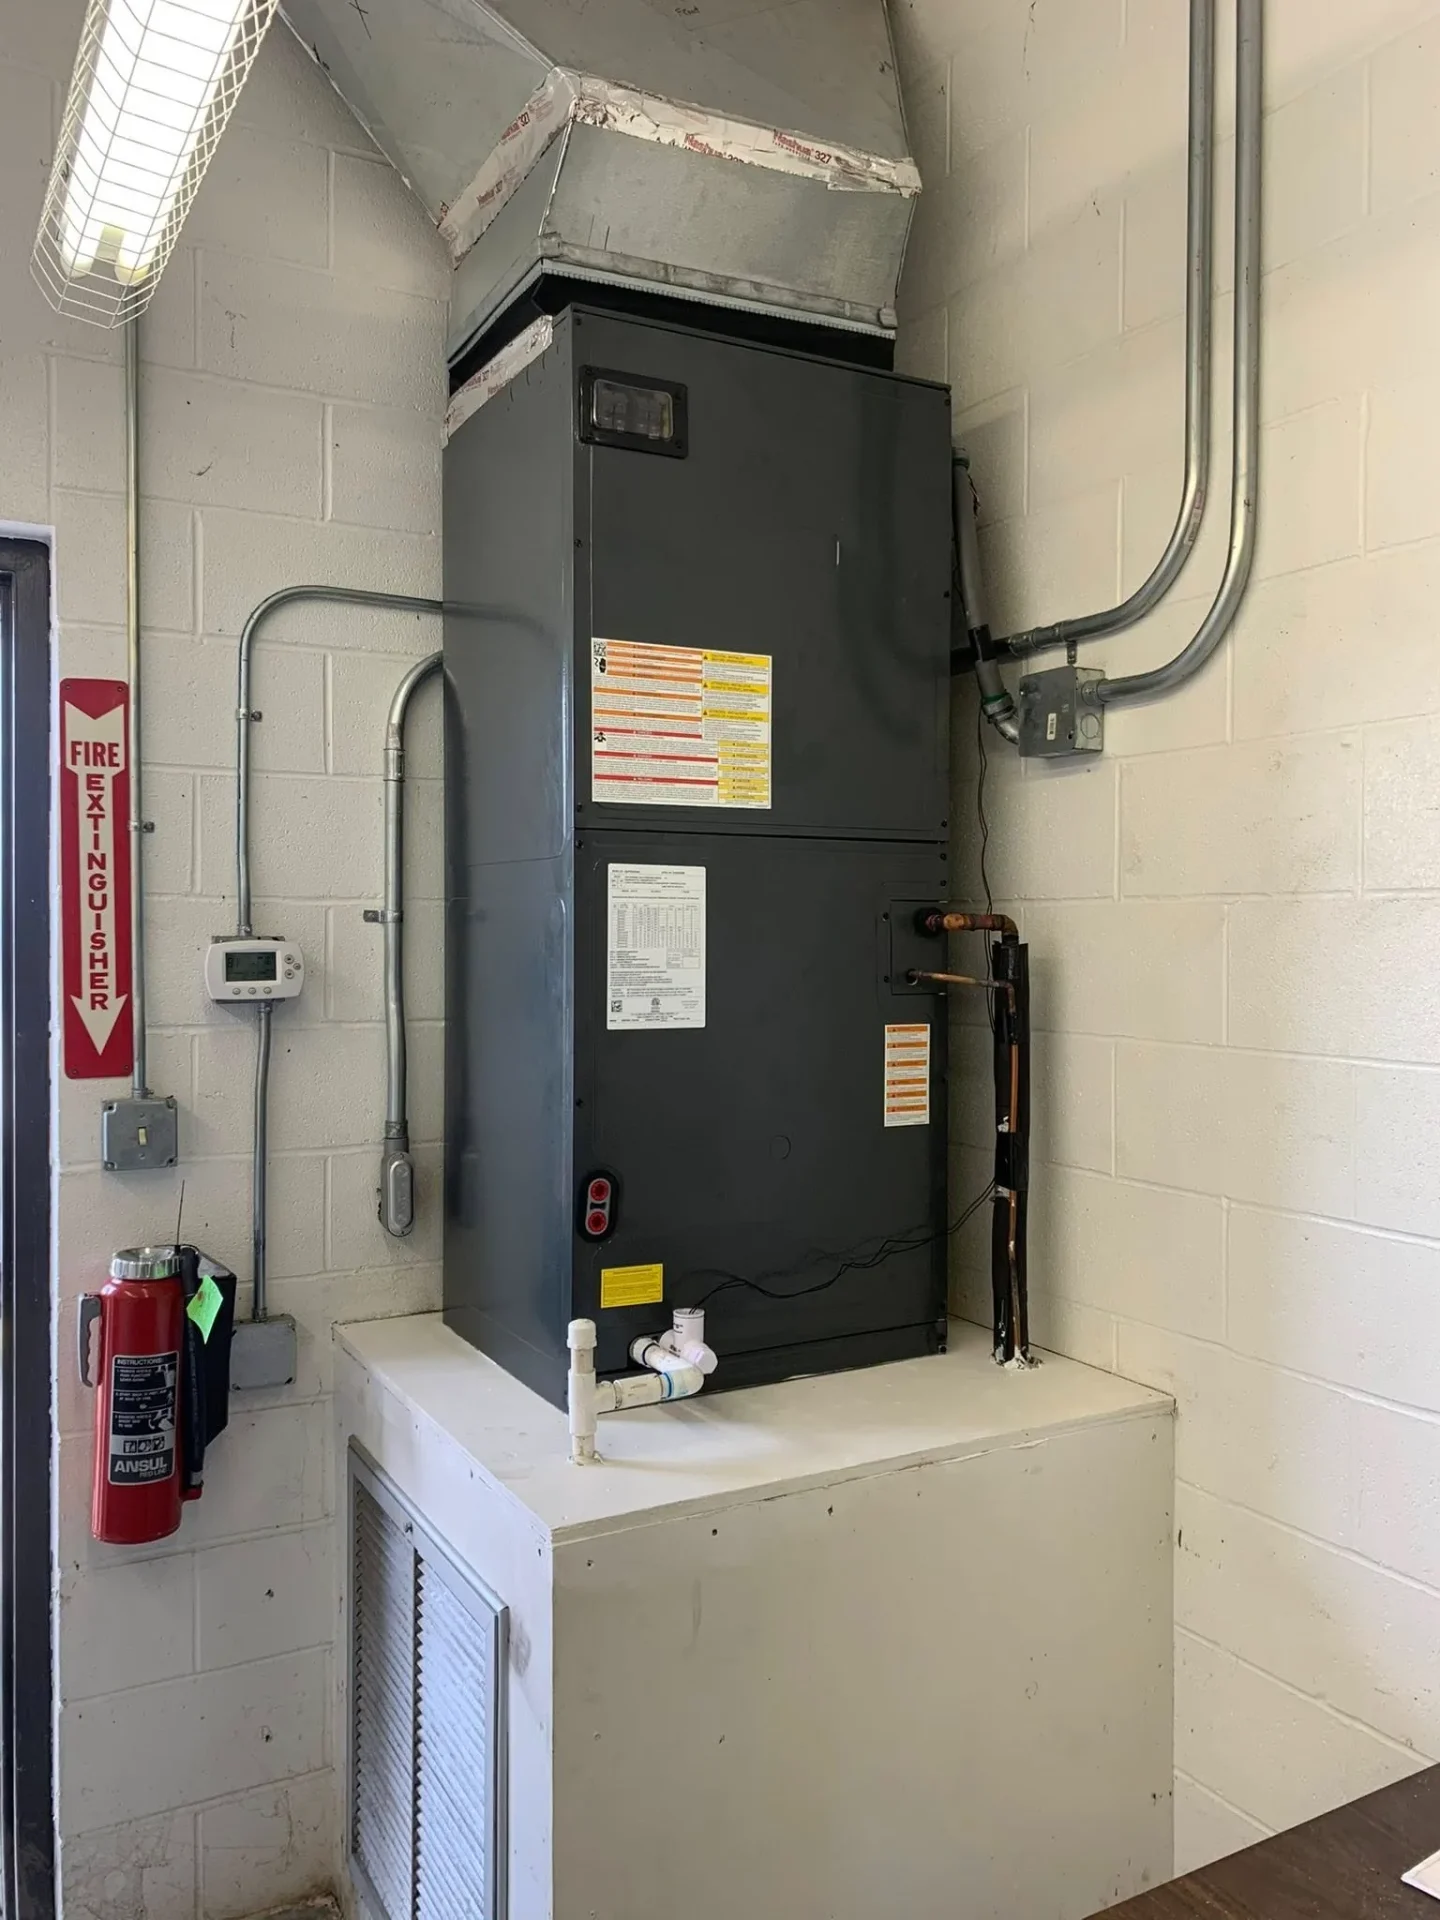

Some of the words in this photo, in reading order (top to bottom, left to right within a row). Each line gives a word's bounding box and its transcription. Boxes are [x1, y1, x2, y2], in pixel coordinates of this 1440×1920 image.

[814, 150, 832, 164] 327
[70, 740, 120, 768] FIRE
[86, 773, 109, 1011] EXTINGUISHER
[117, 1357, 163, 1366] INSTRUCTIONS
[114, 1456, 168, 1473] ANSUL
